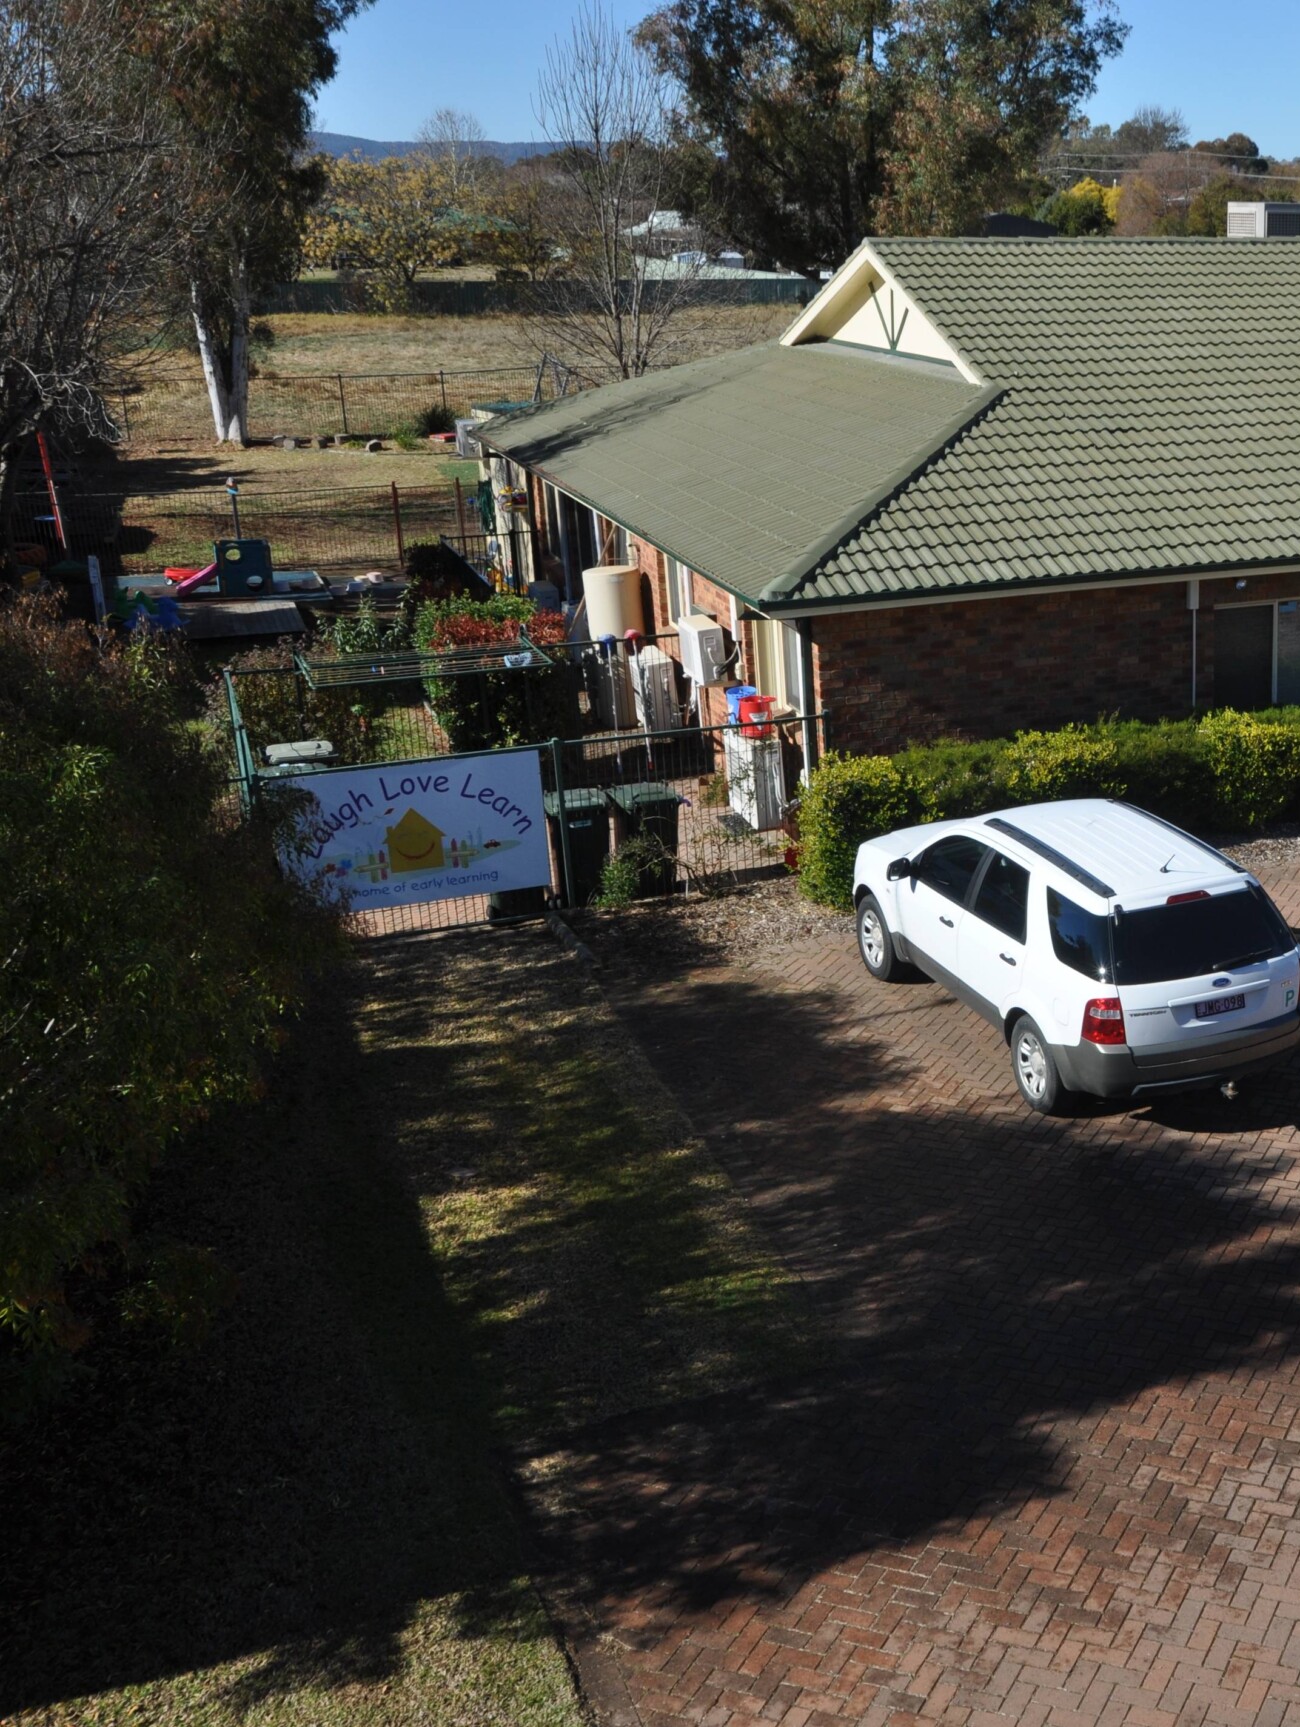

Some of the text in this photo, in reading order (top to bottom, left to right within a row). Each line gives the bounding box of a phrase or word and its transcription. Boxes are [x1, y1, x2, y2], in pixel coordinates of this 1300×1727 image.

[301, 773, 533, 859] Laugh Love Learn
[394, 882, 408, 893] of
[411, 878, 444, 892] early
[447, 870, 499, 887] learning
[1285, 989, 1295, 1008] P
